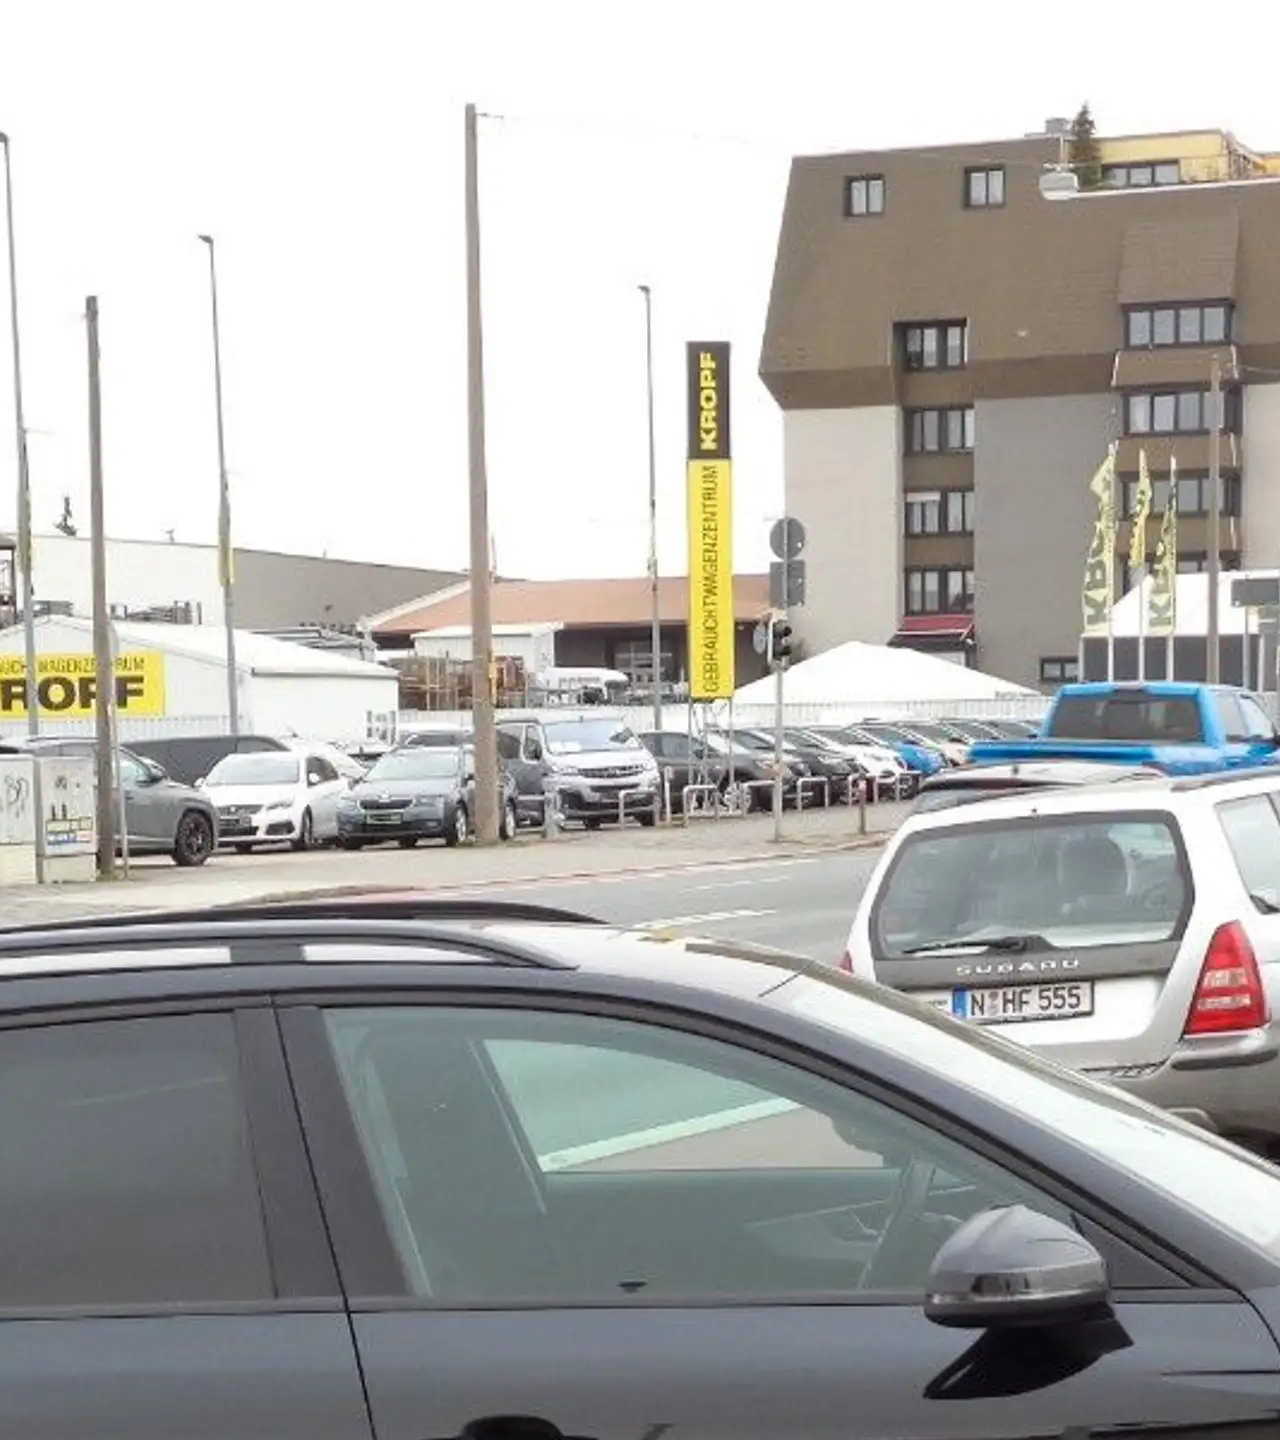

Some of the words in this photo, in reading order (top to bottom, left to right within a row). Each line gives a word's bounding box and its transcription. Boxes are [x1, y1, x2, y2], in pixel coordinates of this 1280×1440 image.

[700, 351, 718, 450] KROPF
[702, 464, 719, 692] GEBRAUCHTWAGENZENTRUM
[956, 958, 1079, 975] SUBARU
[971, 992, 985, 1016] N
[1002, 988, 1033, 1013] HF
[1038, 985, 1081, 1011] 555
